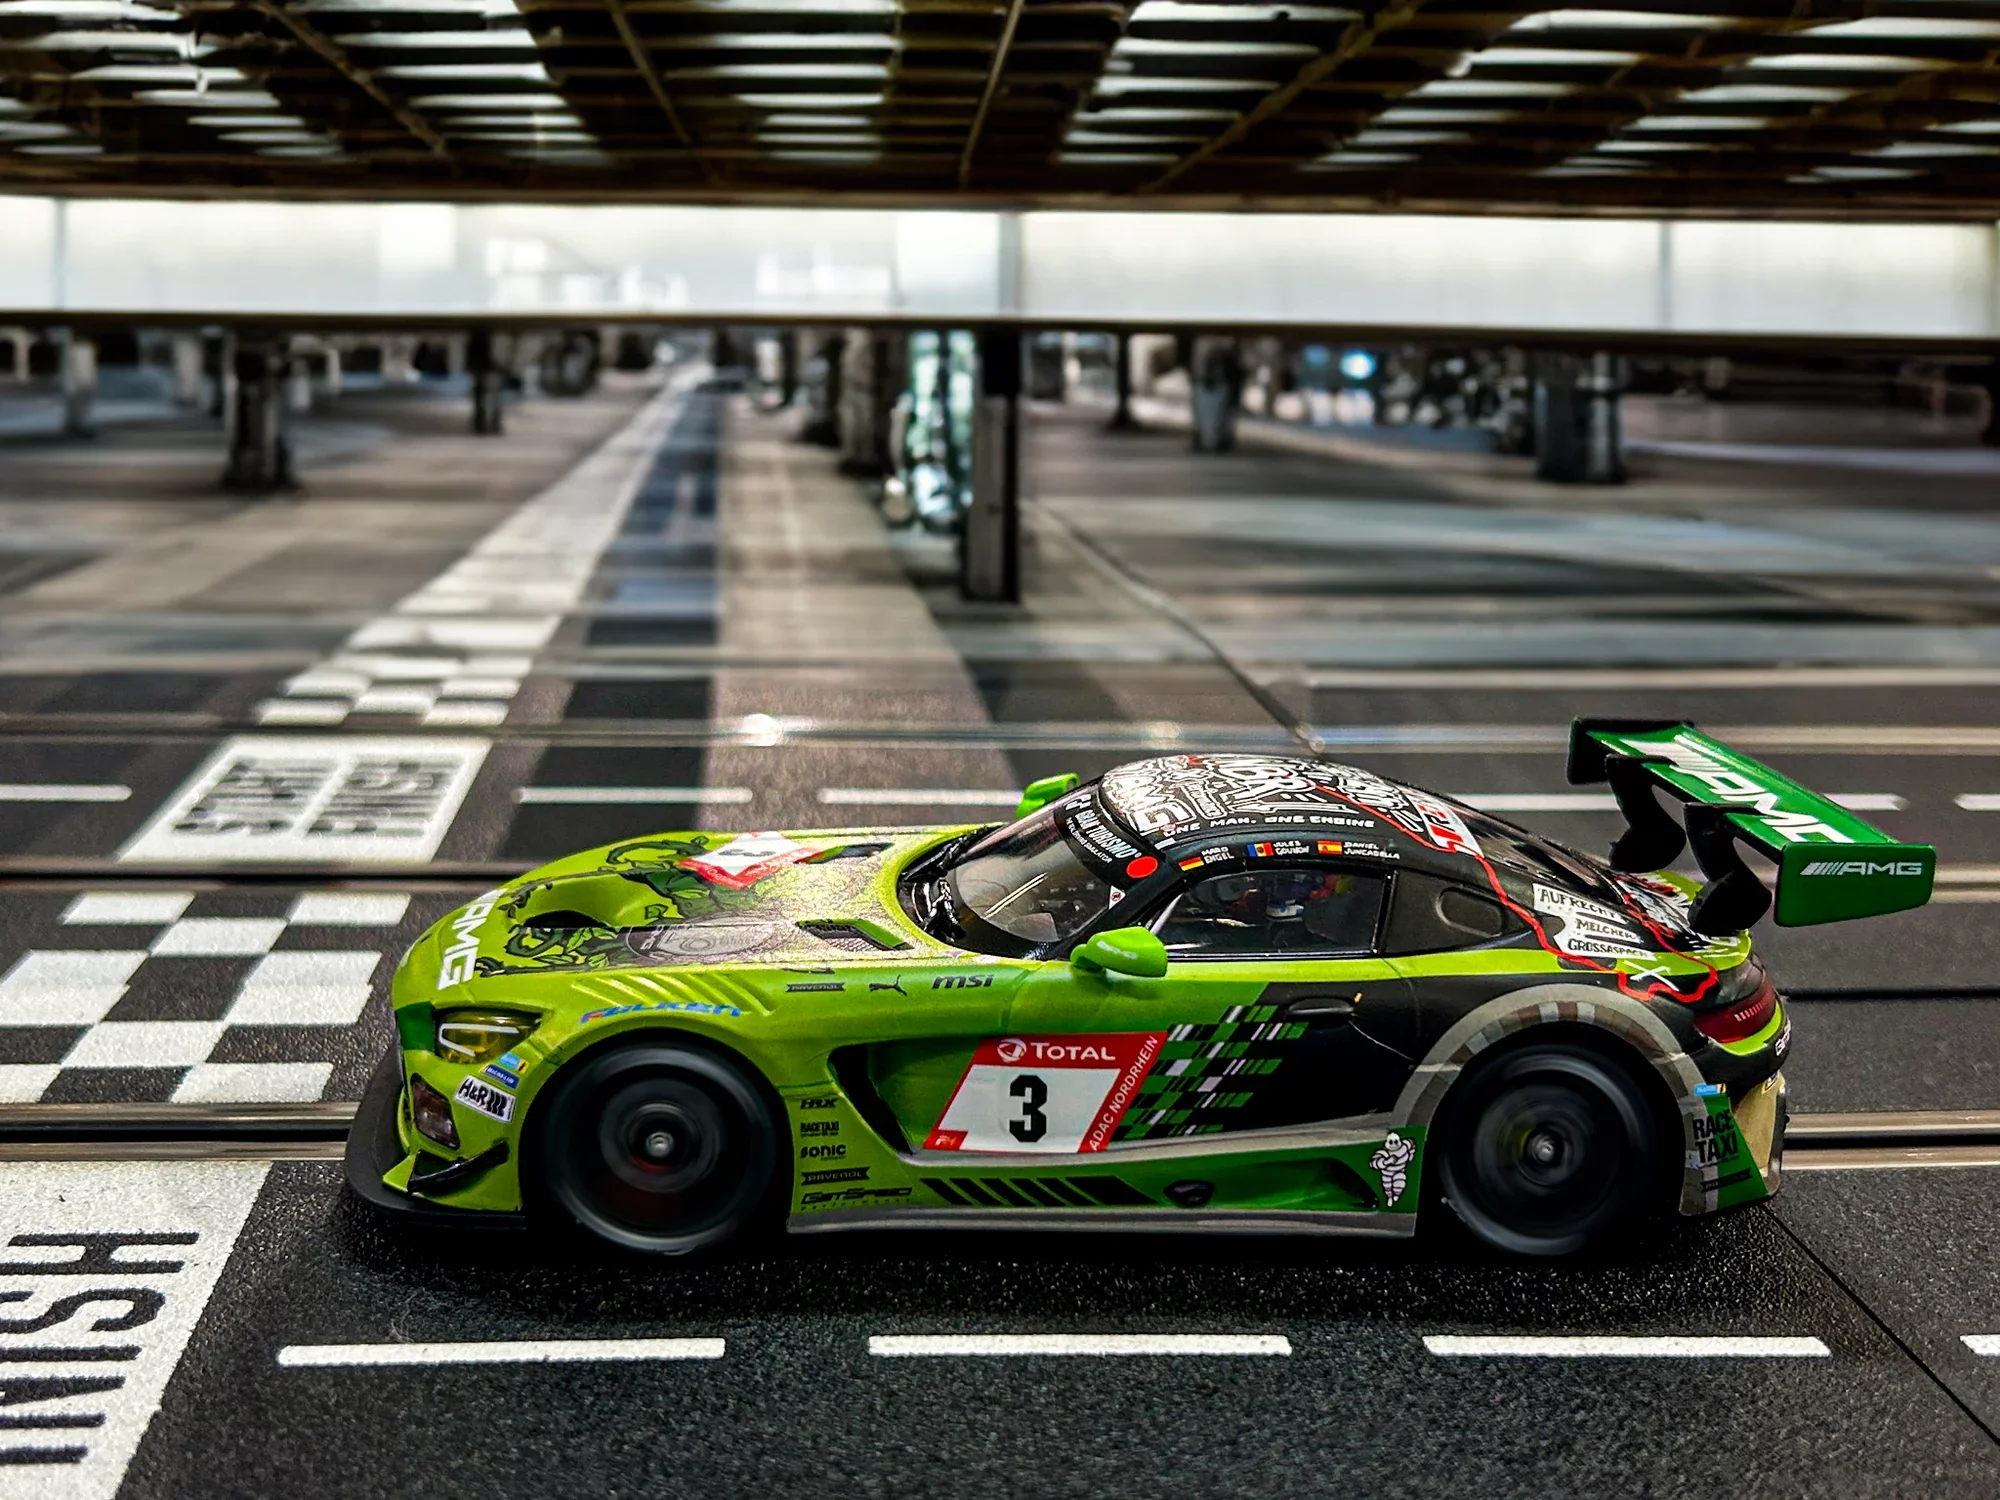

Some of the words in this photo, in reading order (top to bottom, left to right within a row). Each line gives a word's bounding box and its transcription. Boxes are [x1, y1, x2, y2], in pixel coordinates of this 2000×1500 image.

[1264, 815, 1305, 824] ONE
[1086, 824, 1139, 859] TURISMO
[1343, 841, 1379, 850] DANIEL
[931, 974, 995, 990] msi
[1030, 1041, 1116, 1062] TOTAL
[1088, 1113, 1116, 1153] ADAC
[1108, 1034, 1159, 1115] NORDRHEIN
[1008, 1074, 1048, 1143] 3
[1692, 1108, 1735, 1141] RACE
[1694, 1130, 1739, 1164] TAXI
[807, 1170, 863, 1183] RAVENOL
